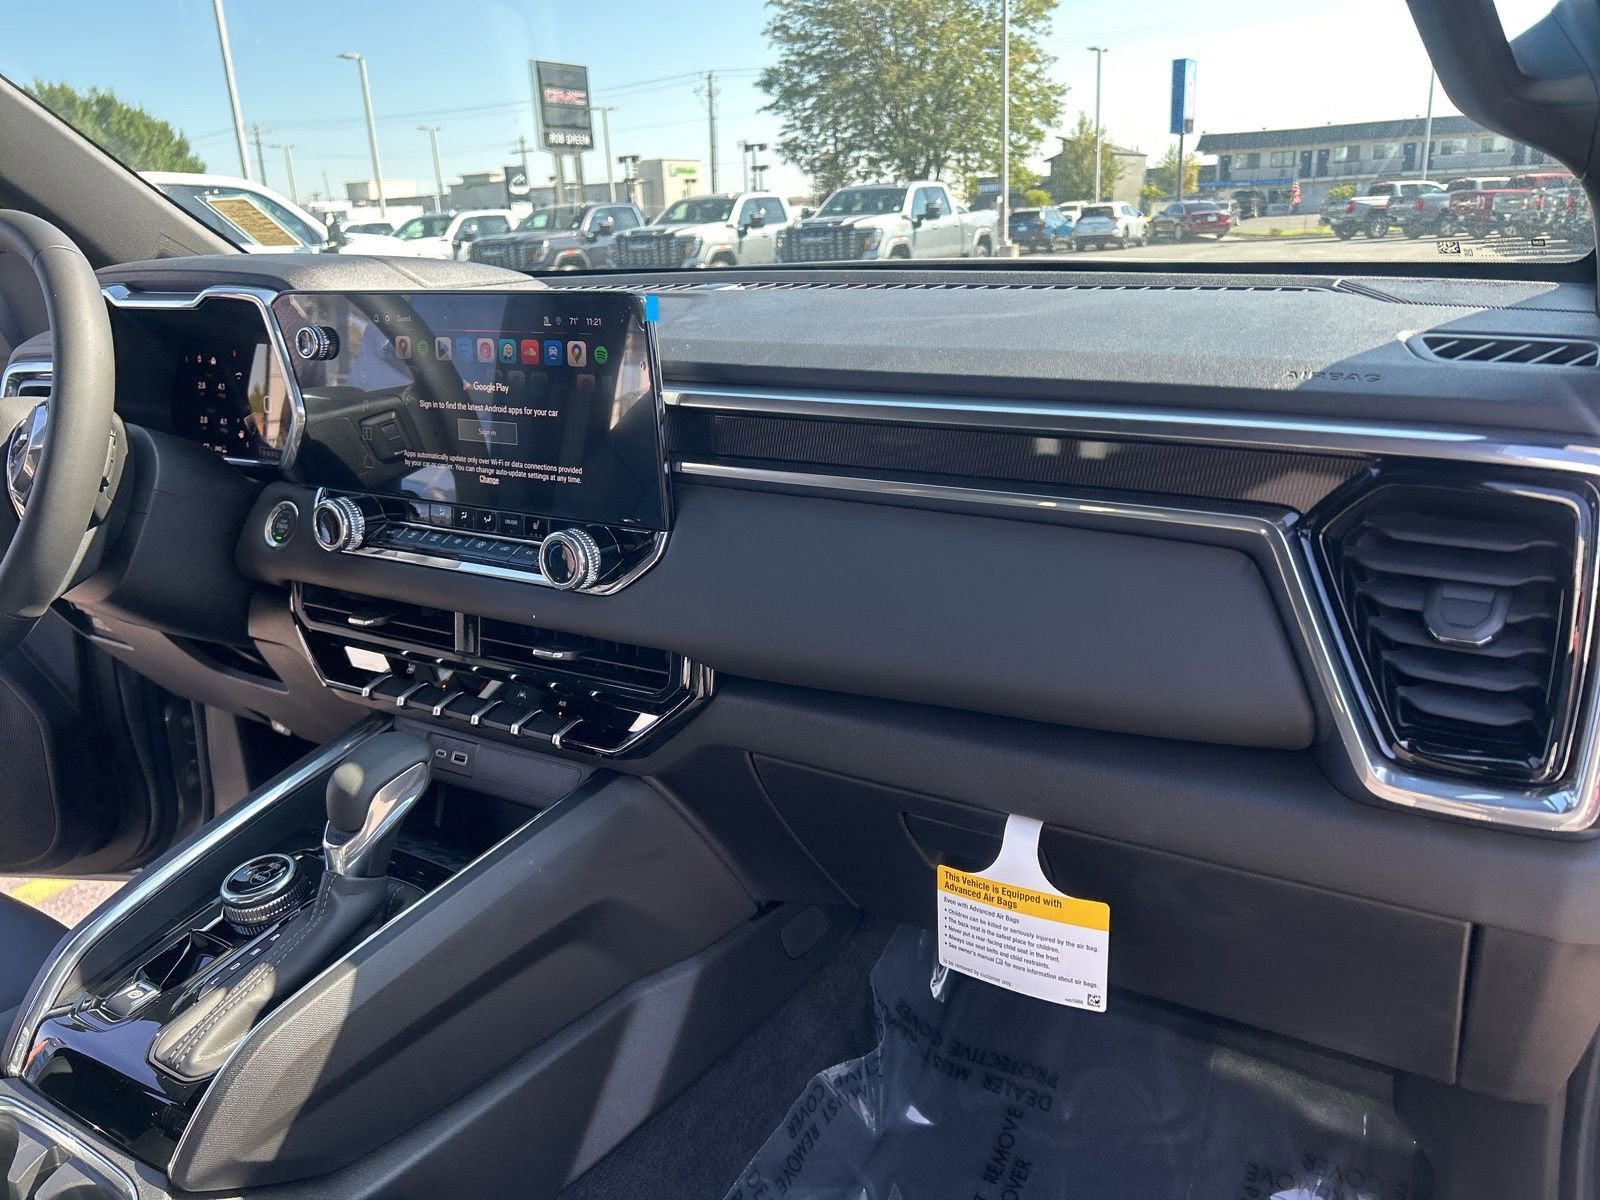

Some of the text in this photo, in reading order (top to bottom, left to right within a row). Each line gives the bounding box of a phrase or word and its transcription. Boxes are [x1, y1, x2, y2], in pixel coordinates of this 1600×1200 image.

[586, 317, 602, 326] 11:21
[473, 382, 509, 395] Google Play
[419, 400, 432, 409] Sign
[433, 401, 438, 409] in
[439, 401, 445, 409] to
[446, 401, 457, 410] find
[457, 402, 467, 411] the
[468, 402, 484, 412] latest
[485, 404, 507, 413] Android
[508, 406, 522, 416] apps
[524, 406, 533, 416] for
[534, 409, 547, 417] your
[478, 428, 490, 437] Sign
[404, 450, 416, 459] Apps
[417, 451, 449, 462] automatically
[449, 454, 466, 464] update
[467, 456, 478, 465] only
[491, 459, 504, 467] Wi-Fi
[511, 461, 524, 469] data
[524, 462, 558, 472] connections
[558, 466, 583, 475] provided
[404, 459, 410, 467] by
[410, 460, 422, 468] your
[476, 466, 495, 475] change
[496, 468, 527, 478] auto-update
[527, 472, 549, 481] settings
[568, 475, 582, 483] time.
[479, 475, 499, 485] Change
[944, 881, 1018, 909] Advanced Air Bags
[945, 871, 1062, 908] This Vehicle is Equipped with
[944, 896, 956, 905] Even
[957, 901, 968, 909] with
[969, 905, 995, 917] Advanced
[1006, 915, 1020, 924] Bags
[948, 908, 968, 919] Children
[987, 921, 1002, 930] killed
[1010, 928, 1034, 939] seriously
[1036, 934, 1056, 943] injured
[1057, 938, 1064, 946] by
[1086, 945, 1099, 953] bag.
[948, 916, 956, 924] The
[958, 920, 969, 928] back
[970, 924, 980, 932] seat
[996, 932, 1011, 941] safest
[1012, 937, 1026, 946] place
[1036, 943, 1060, 953] children.
[948, 925, 961, 935] Never
[962, 930, 970, 938] put
[976, 935, 1002, 948] rear-facing
[1004, 942, 1016, 951] child
[1046, 954, 1060, 963] front.
[948, 934, 965, 944] Always
[975, 943, 986, 951] seat
[986, 946, 998, 955] belts
[1010, 954, 1023, 963] child
[1024, 958, 1050, 969] restraints.
[948, 942, 957, 950] See
[958, 946, 976, 956] owner's
[977, 952, 994, 962] manual
[1027, 967, 1056, 980] information
[1058, 975, 1073, 984] about
[1083, 980, 1098, 989] bags.
[955, 963, 973, 973] removed
[980, 972, 1000, 983] customer
[948, 1040, 1059, 1089] PROTECTIVE
[982, 1073, 1054, 1112] DEALER
[787, 1083, 826, 1139] COVER
[775, 1127, 821, 1197] REMOVE
[982, 1106, 1024, 1185] REMOVE
[1000, 1158, 1034, 1200] OVER
